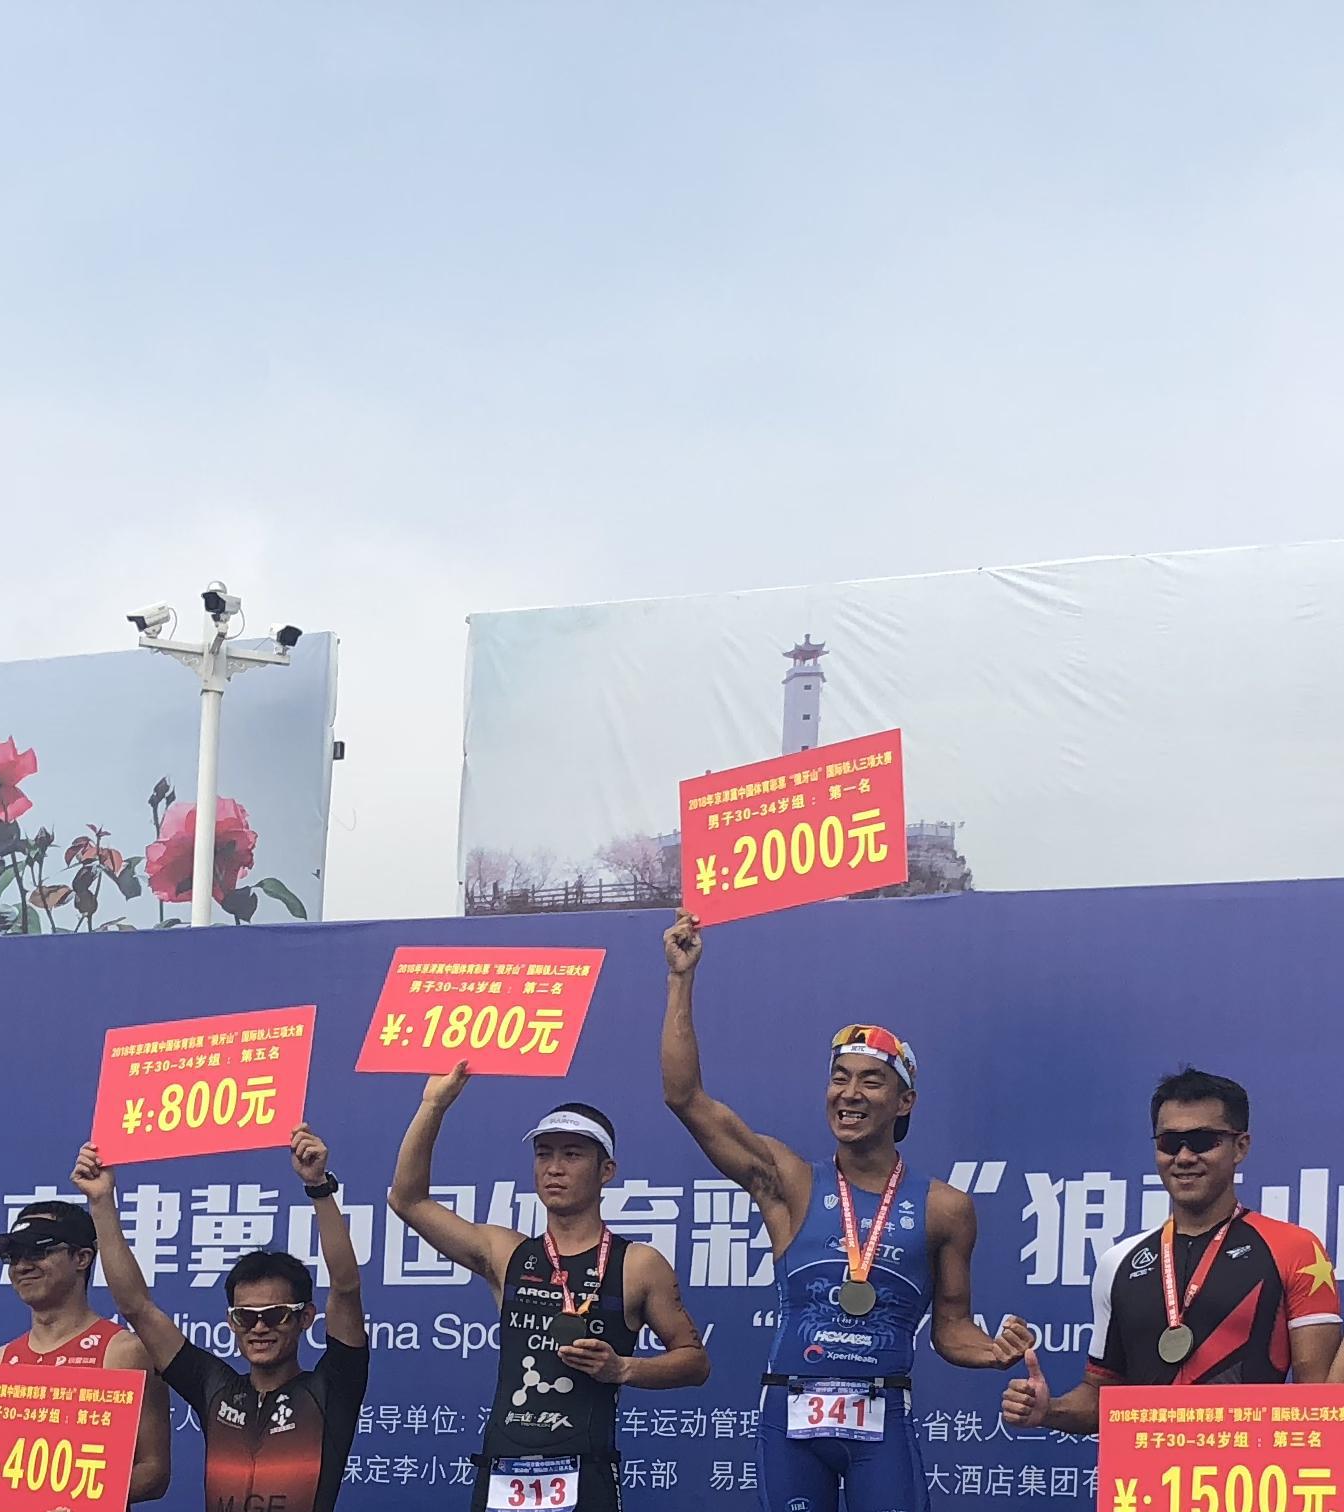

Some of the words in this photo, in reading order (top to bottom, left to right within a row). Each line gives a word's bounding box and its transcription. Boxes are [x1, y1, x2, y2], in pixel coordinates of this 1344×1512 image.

[828, 777, 872, 801] 第一名
[695, 807, 889, 896] ¥:2000元
[522, 980, 564, 995] 第二名
[379, 1004, 564, 1055] ¥:1800元
[239, 1045, 281, 1064] 第五名
[120, 1075, 278, 1135] ¥:800元
[516, 1286, 575, 1300] ARGO
[76, 1409, 112, 1427] 第七名
[807, 1396, 866, 1427] 341
[1271, 1430, 1323, 1449] 第三名
[507, 1477, 567, 1507] 313
